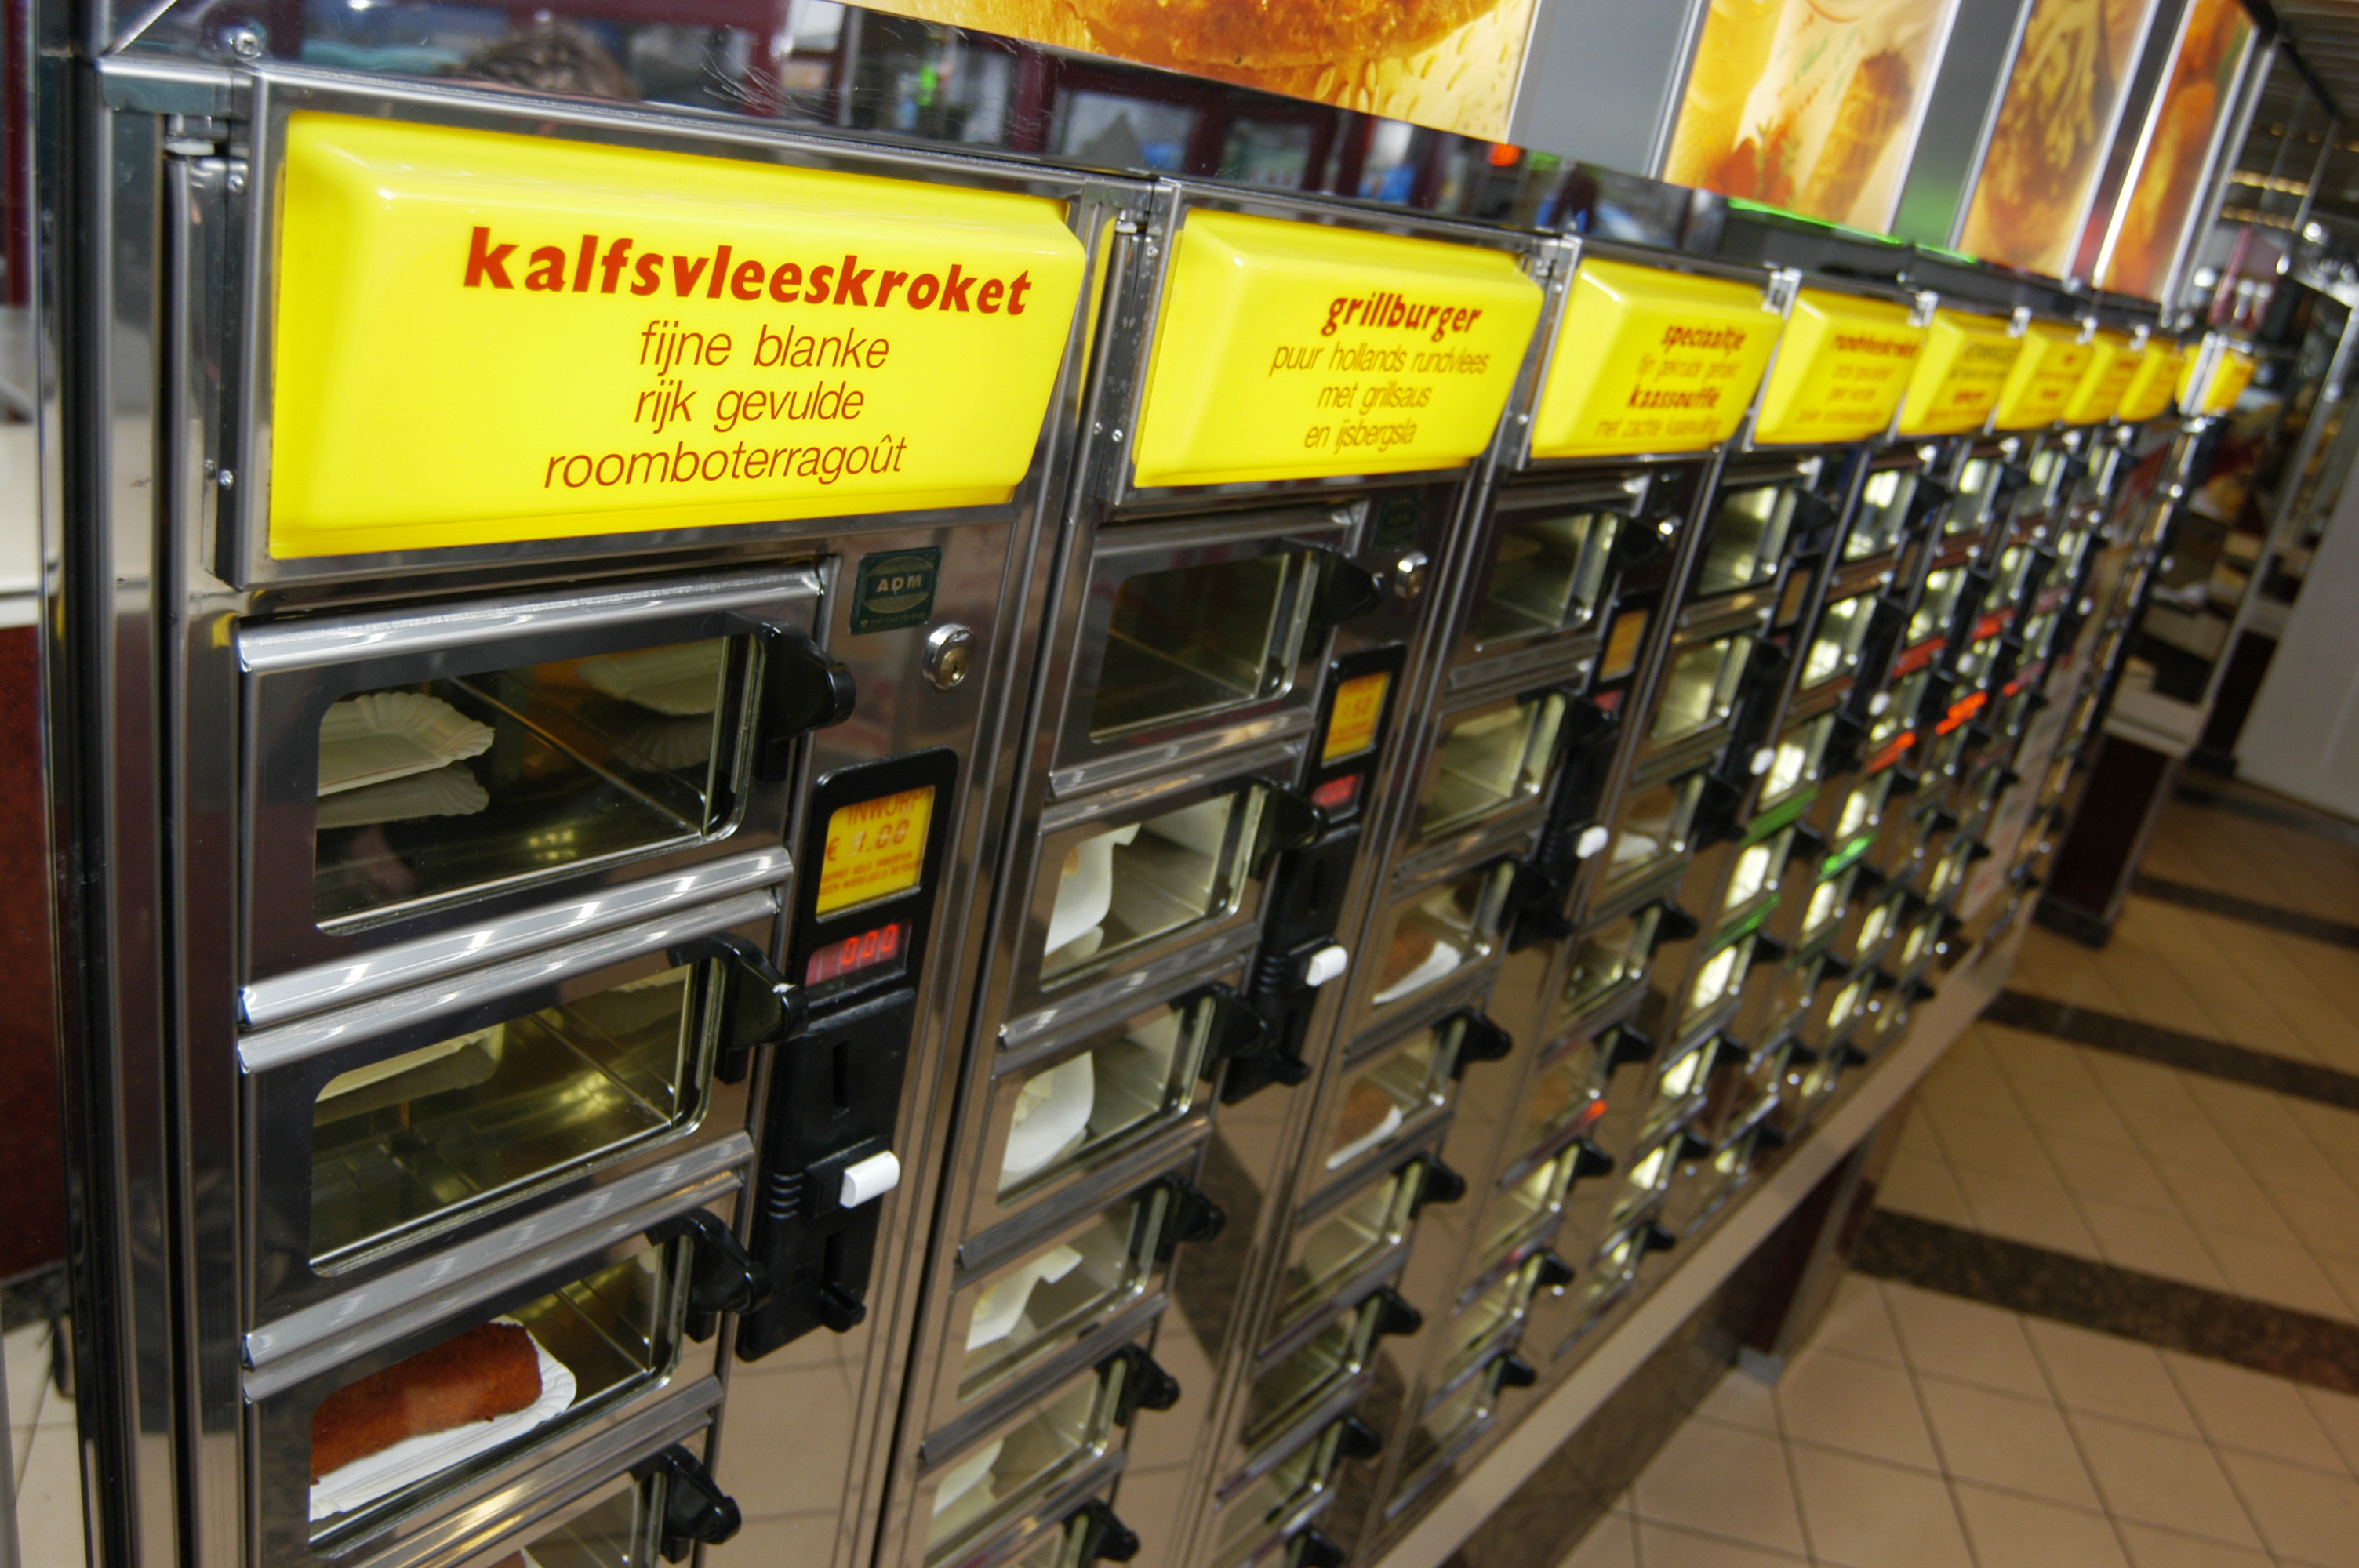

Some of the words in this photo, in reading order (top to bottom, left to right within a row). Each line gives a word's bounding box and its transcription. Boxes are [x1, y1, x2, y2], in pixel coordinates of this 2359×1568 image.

[463, 227, 1033, 315] kalfsvleeskroket
[1321, 292, 1482, 343] grillburger
[638, 321, 731, 376] fijne
[753, 324, 889, 370] blanke
[1268, 345, 1325, 378] puur
[1329, 341, 1407, 373] hollands
[1411, 345, 1490, 375] rundvlees
[634, 380, 696, 433] rijk
[715, 381, 863, 433] gevulde
[1317, 381, 1359, 408] met
[1358, 379, 1432, 416] grillsaus
[1303, 425, 1330, 448] en
[1333, 417, 1417, 455] ijsbergsla
[544, 434, 907, 489] roomboterragoût
[876, 575, 922, 593] ADM
[826, 837, 840, 862] €
